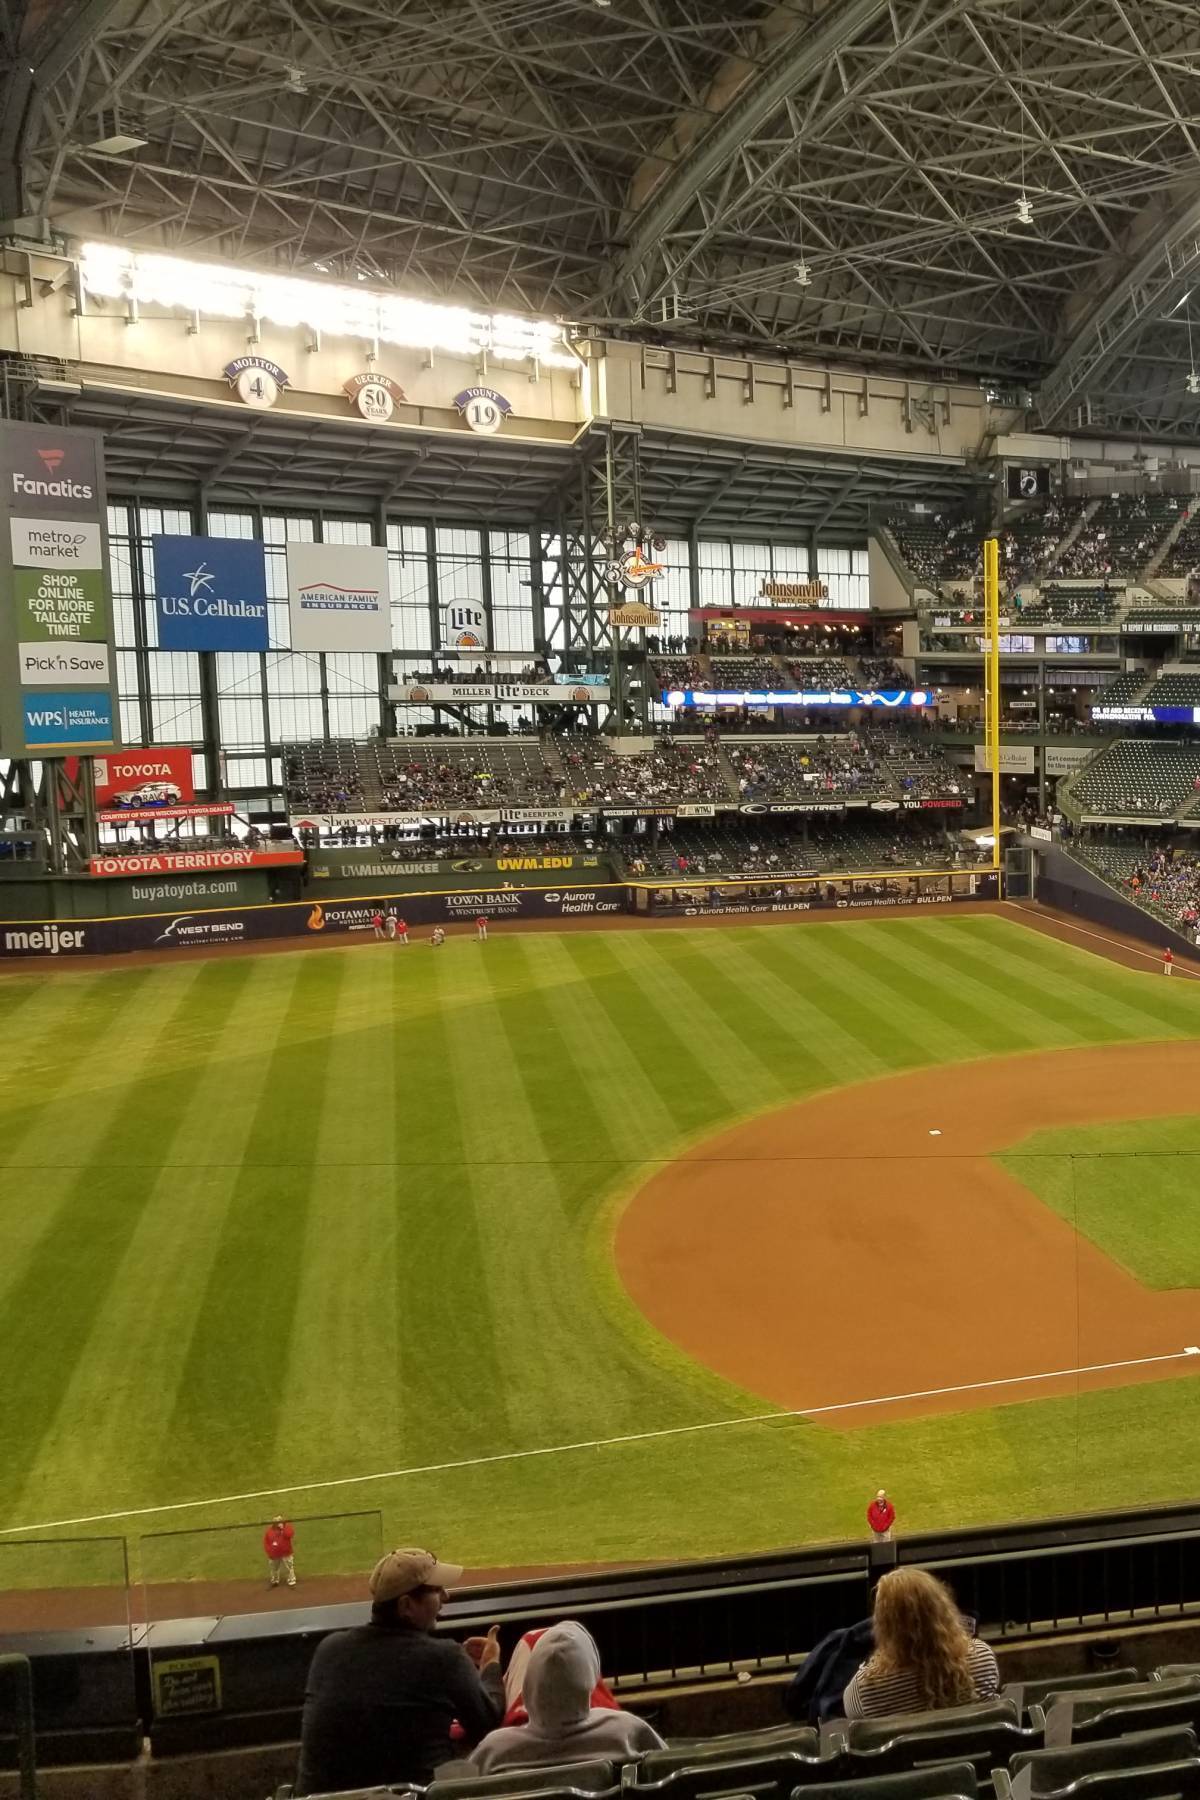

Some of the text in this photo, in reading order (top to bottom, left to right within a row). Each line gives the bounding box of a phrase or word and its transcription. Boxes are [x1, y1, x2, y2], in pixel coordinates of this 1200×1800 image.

[232, 357, 279, 376] MOLITOR
[354, 374, 392, 387] UECKER
[249, 377, 264, 399] 4
[365, 389, 387, 407] 50
[466, 389, 499, 401] YOUNT
[471, 404, 497, 425] 19
[12, 473, 93, 499] Fanatics
[28, 530, 72, 543] metro
[29, 545, 80, 558] market
[42, 575, 78, 587] SHOP
[37, 587, 85, 600] ONLINE
[758, 578, 829, 598] Johnsonville
[300, 593, 378, 603] AMERICAN FAMILY
[28, 599, 95, 612] FOR MORE
[161, 597, 265, 618] U.S. Cellular
[305, 602, 374, 610] INSURANCE
[33, 611, 92, 624] TAILGATE
[450, 607, 482, 630] Lite
[611, 610, 659, 625] Johnsonville
[46, 624, 81, 636] TIME!
[25, 657, 55, 670] Pick
[70, 657, 104, 670] Save
[452, 685, 550, 700] MILLER Lite DECK
[27, 711, 63, 727] WPS
[69, 710, 96, 718] HEALTH
[69, 717, 109, 726] INSURANCE
[113, 764, 172, 778] TOYOTA
[100, 812, 131, 821] COURTESY
[139, 810, 156, 818] YOUR
[156, 809, 188, 818] WISCONSIN
[188, 807, 209, 815] TOYOTA
[209, 805, 233, 813] DEALERS
[94, 852, 254, 874] TOYOTA TERRITORY
[496, 857, 574, 871] UWM.EDU
[131, 881, 238, 901] buyatoyota.com
[563, 893, 596, 901] Aurora
[444, 893, 523, 906] TOWN BANK
[916, 895, 952, 904] BULLPEN
[456, 907, 495, 916] WINTRUST
[497, 906, 519, 914] BANK
[561, 902, 619, 913] Health Care
[699, 906, 725, 915] Aurora
[725, 904, 750, 914] Health
[771, 903, 811, 912] BULLPEN
[177, 922, 244, 935] WEST BEND
[5, 925, 86, 954] meijer
